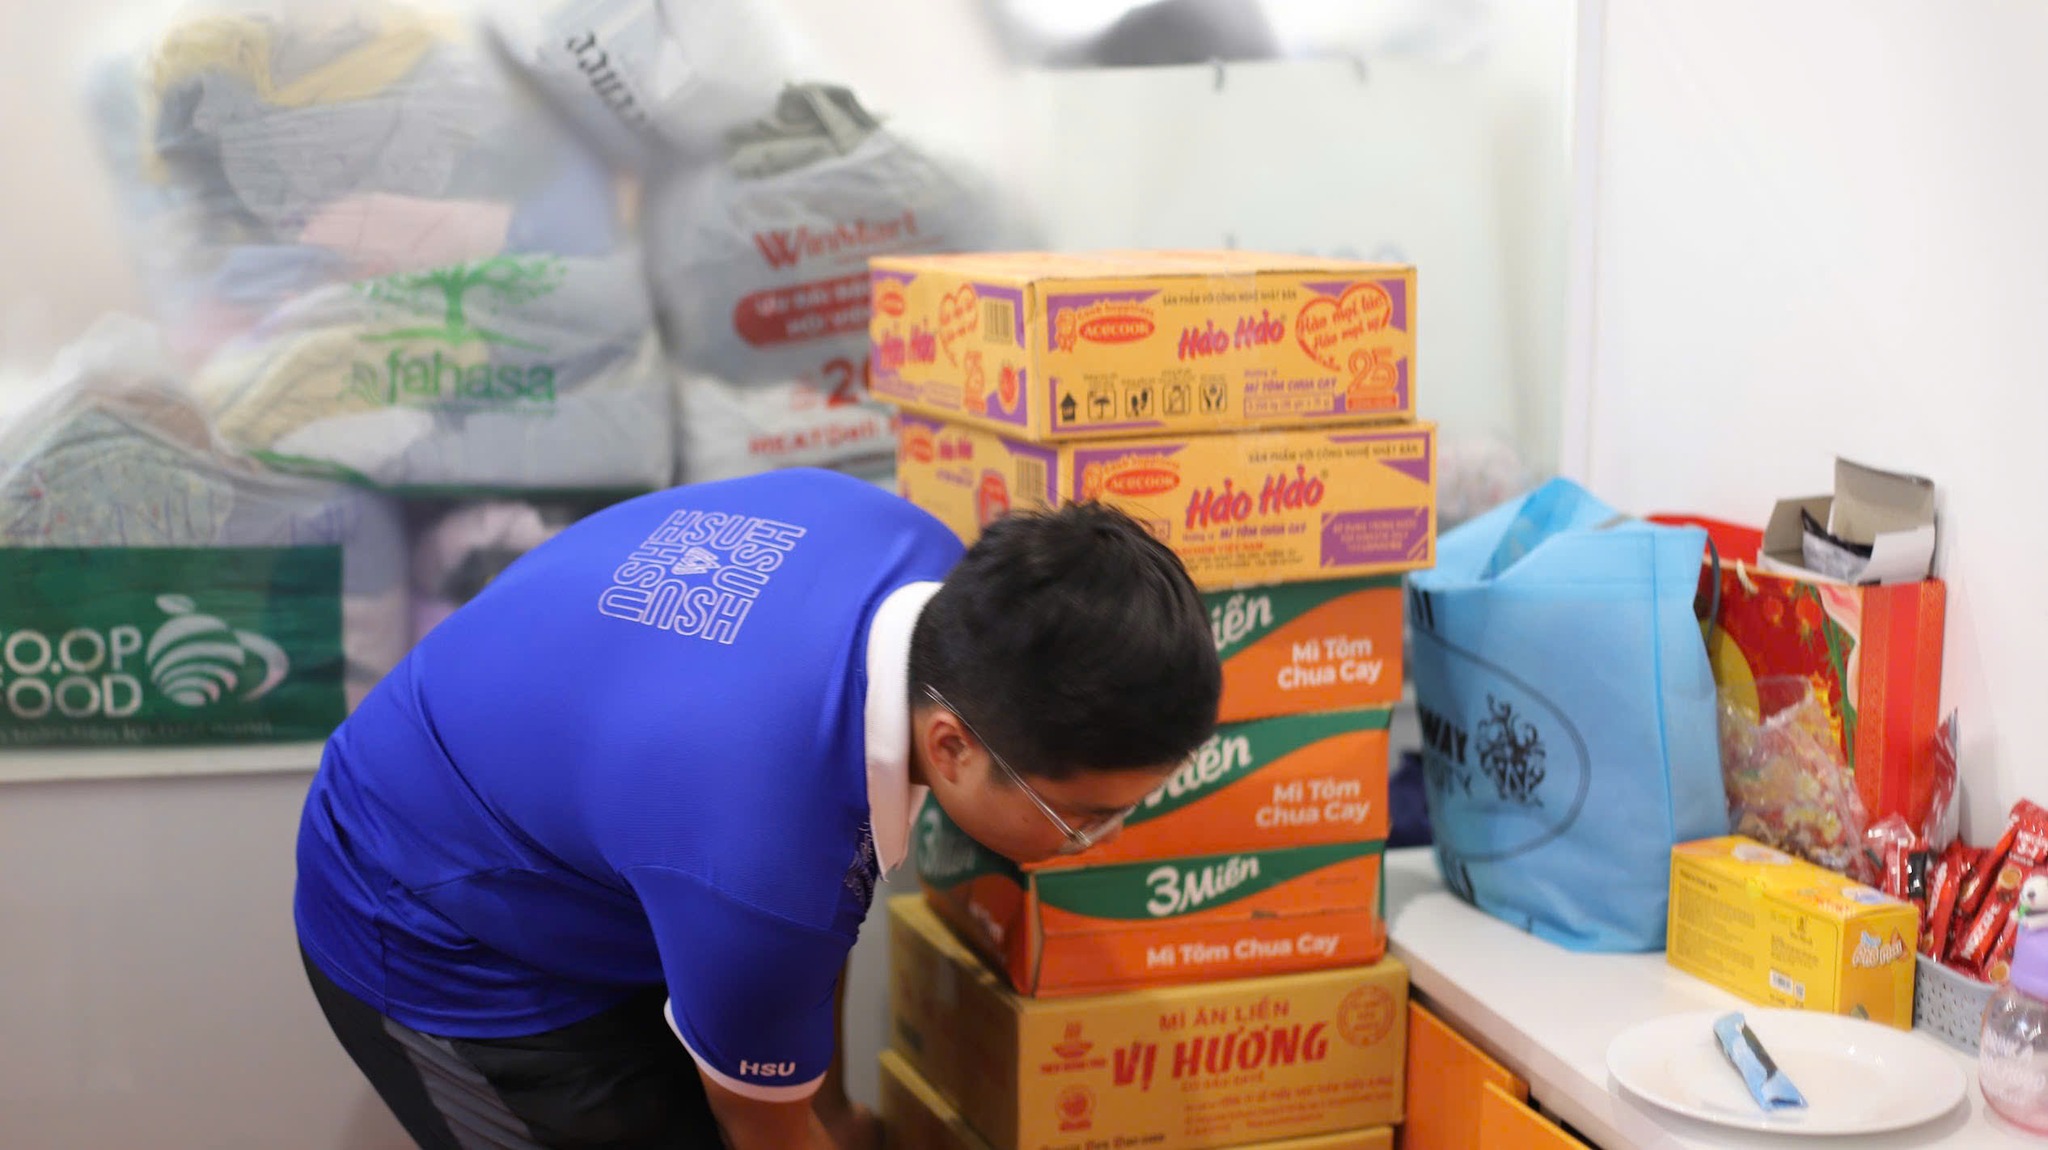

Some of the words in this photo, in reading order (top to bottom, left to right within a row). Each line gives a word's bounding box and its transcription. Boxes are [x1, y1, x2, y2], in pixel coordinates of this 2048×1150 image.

[386, 348, 557, 405] fahasa
[1185, 477, 1253, 531] Hảo
[1259, 463, 1325, 515] Hảo
[648, 509, 762, 551] HSU
[0, 624, 142, 675] O.OP
[1323, 634, 1372, 660] Tôm
[1277, 664, 1337, 690] Chua
[1340, 658, 1384, 685] Cay
[0, 672, 143, 719] OOD
[1308, 776, 1361, 803] Tôm
[1255, 803, 1320, 828] Chua
[1325, 799, 1371, 824] Cay
[1179, 938, 1230, 964] Tôm
[1234, 936, 1294, 959] Chua
[1297, 931, 1341, 958] Cay
[739, 1059, 797, 1078] HSU
[1113, 1040, 1159, 1094] VỊ
[1171, 1019, 1329, 1081] HƯƠNG
